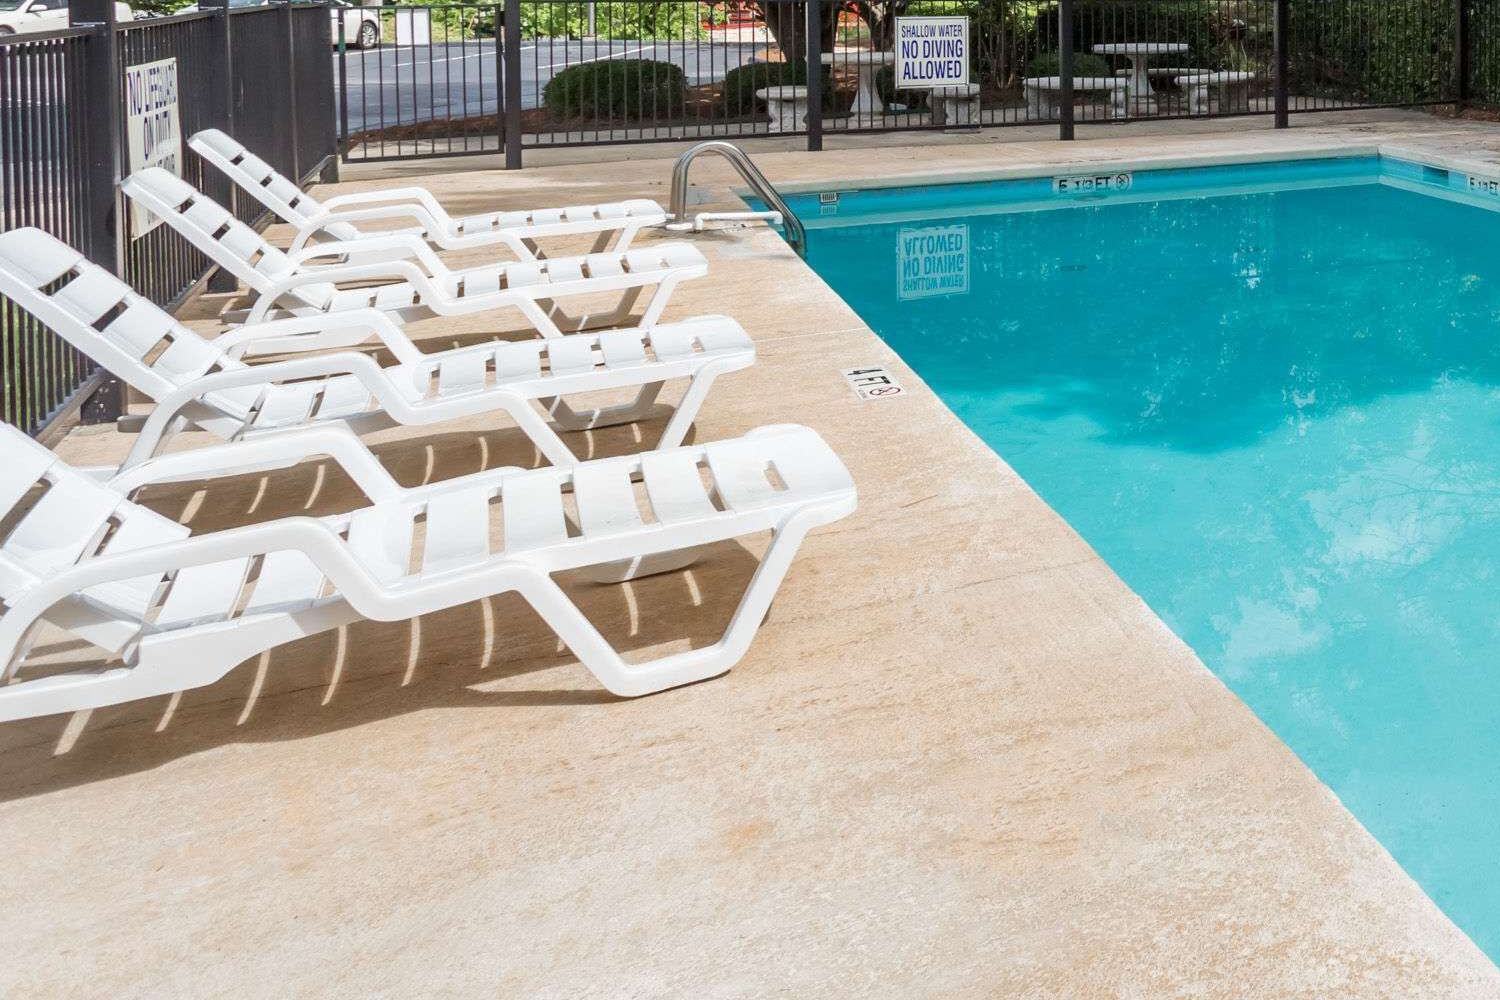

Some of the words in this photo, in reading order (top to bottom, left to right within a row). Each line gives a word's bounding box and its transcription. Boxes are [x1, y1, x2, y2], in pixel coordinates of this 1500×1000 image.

[901, 25, 936, 38] SHALLOW
[938, 24, 963, 37] WATER
[902, 40, 919, 59] NO
[922, 39, 963, 58] DIVING
[903, 60, 962, 80] ALLOWED
[127, 70, 143, 117] NO
[1095, 176, 1111, 189] FT
[853, 375, 892, 387] FT
